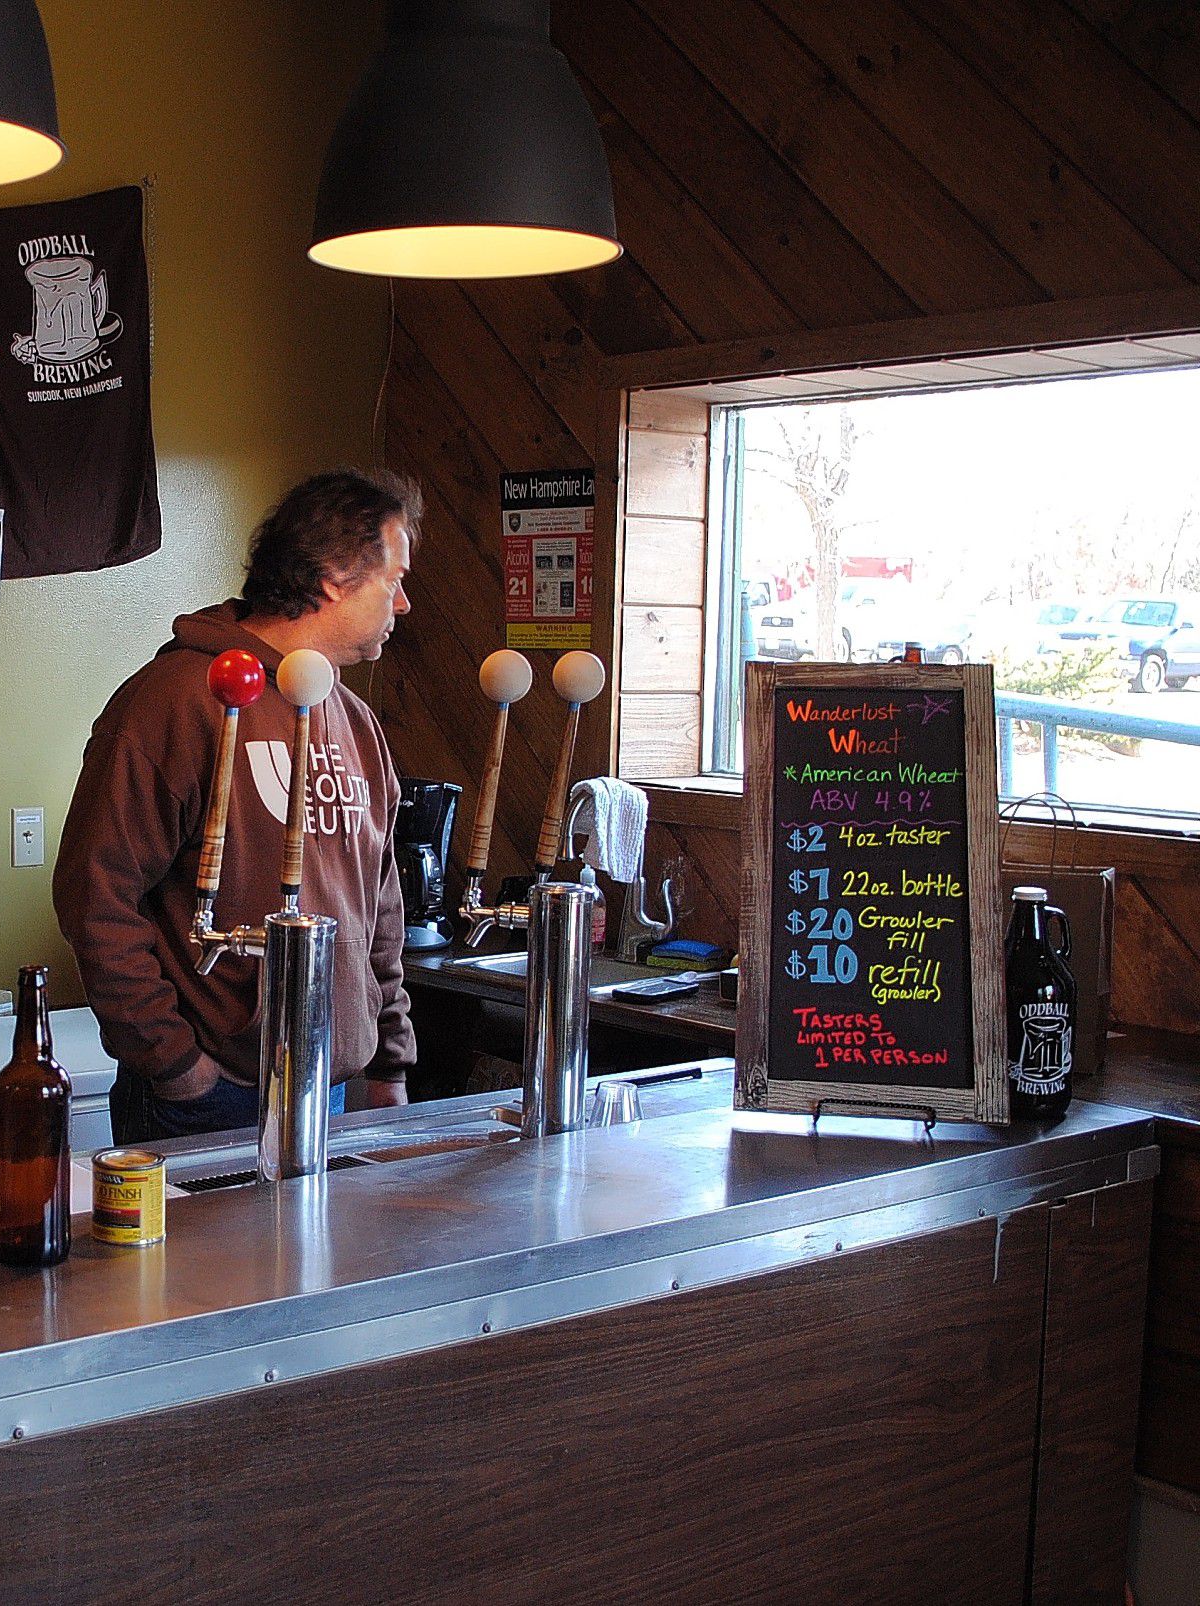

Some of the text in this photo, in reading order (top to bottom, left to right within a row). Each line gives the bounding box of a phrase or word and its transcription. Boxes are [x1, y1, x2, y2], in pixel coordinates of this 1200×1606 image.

[18, 235, 95, 266] ODDBALL
[33, 350, 113, 384] BREWING
[63, 387, 83, 400] NEW
[82, 376, 123, 397] HAMPSHIRE
[504, 478, 528, 500] New
[530, 475, 580, 503] Hampshire
[509, 577, 527, 596] 21
[786, 699, 900, 723] Wanderlust
[828, 728, 906, 755] Wheat
[898, 762, 963, 785] Wheat
[810, 789, 859, 812] ABV
[786, 825, 827, 852] $2
[886, 824, 950, 846] taster
[788, 867, 830, 901] $7
[901, 869, 964, 897] bottle
[785, 906, 955, 941] $20 Growler
[887, 931, 926, 953] fill
[784, 944, 941, 986] $10 refill
[871, 982, 942, 1005] (growler)
[1019, 1002, 1070, 1018] ODDBALL
[815, 1047, 949, 1068] 1 PER PERSON
[1016, 1077, 1066, 1096] BREWING
